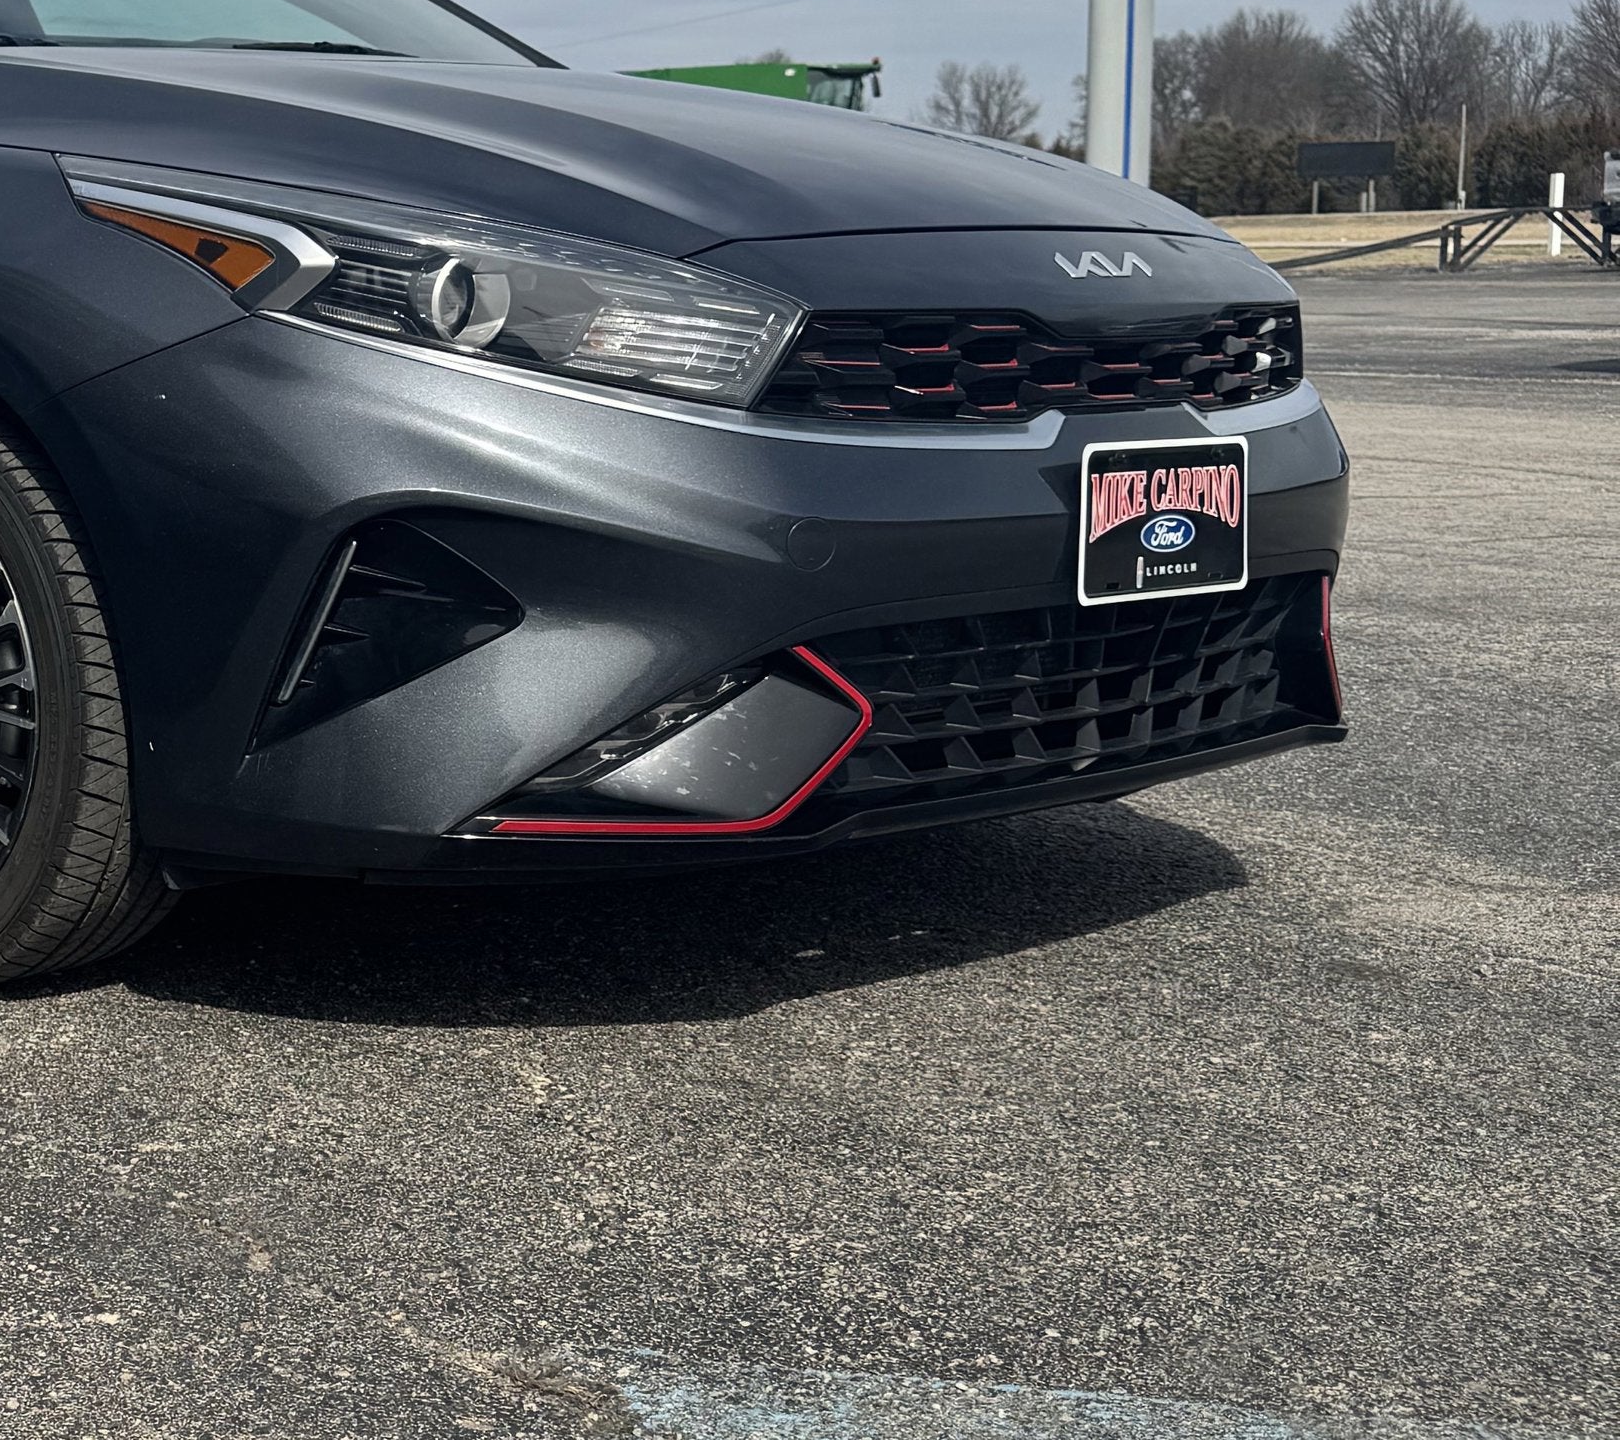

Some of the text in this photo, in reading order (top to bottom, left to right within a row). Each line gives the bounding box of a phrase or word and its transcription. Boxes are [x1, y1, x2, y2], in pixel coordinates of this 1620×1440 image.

[1054, 251, 1153, 278] KIA
[1089, 464, 1241, 544] MIKE CARPINO
[1150, 520, 1186, 547] Ford
[1146, 562, 1197, 577] LINCOLN
